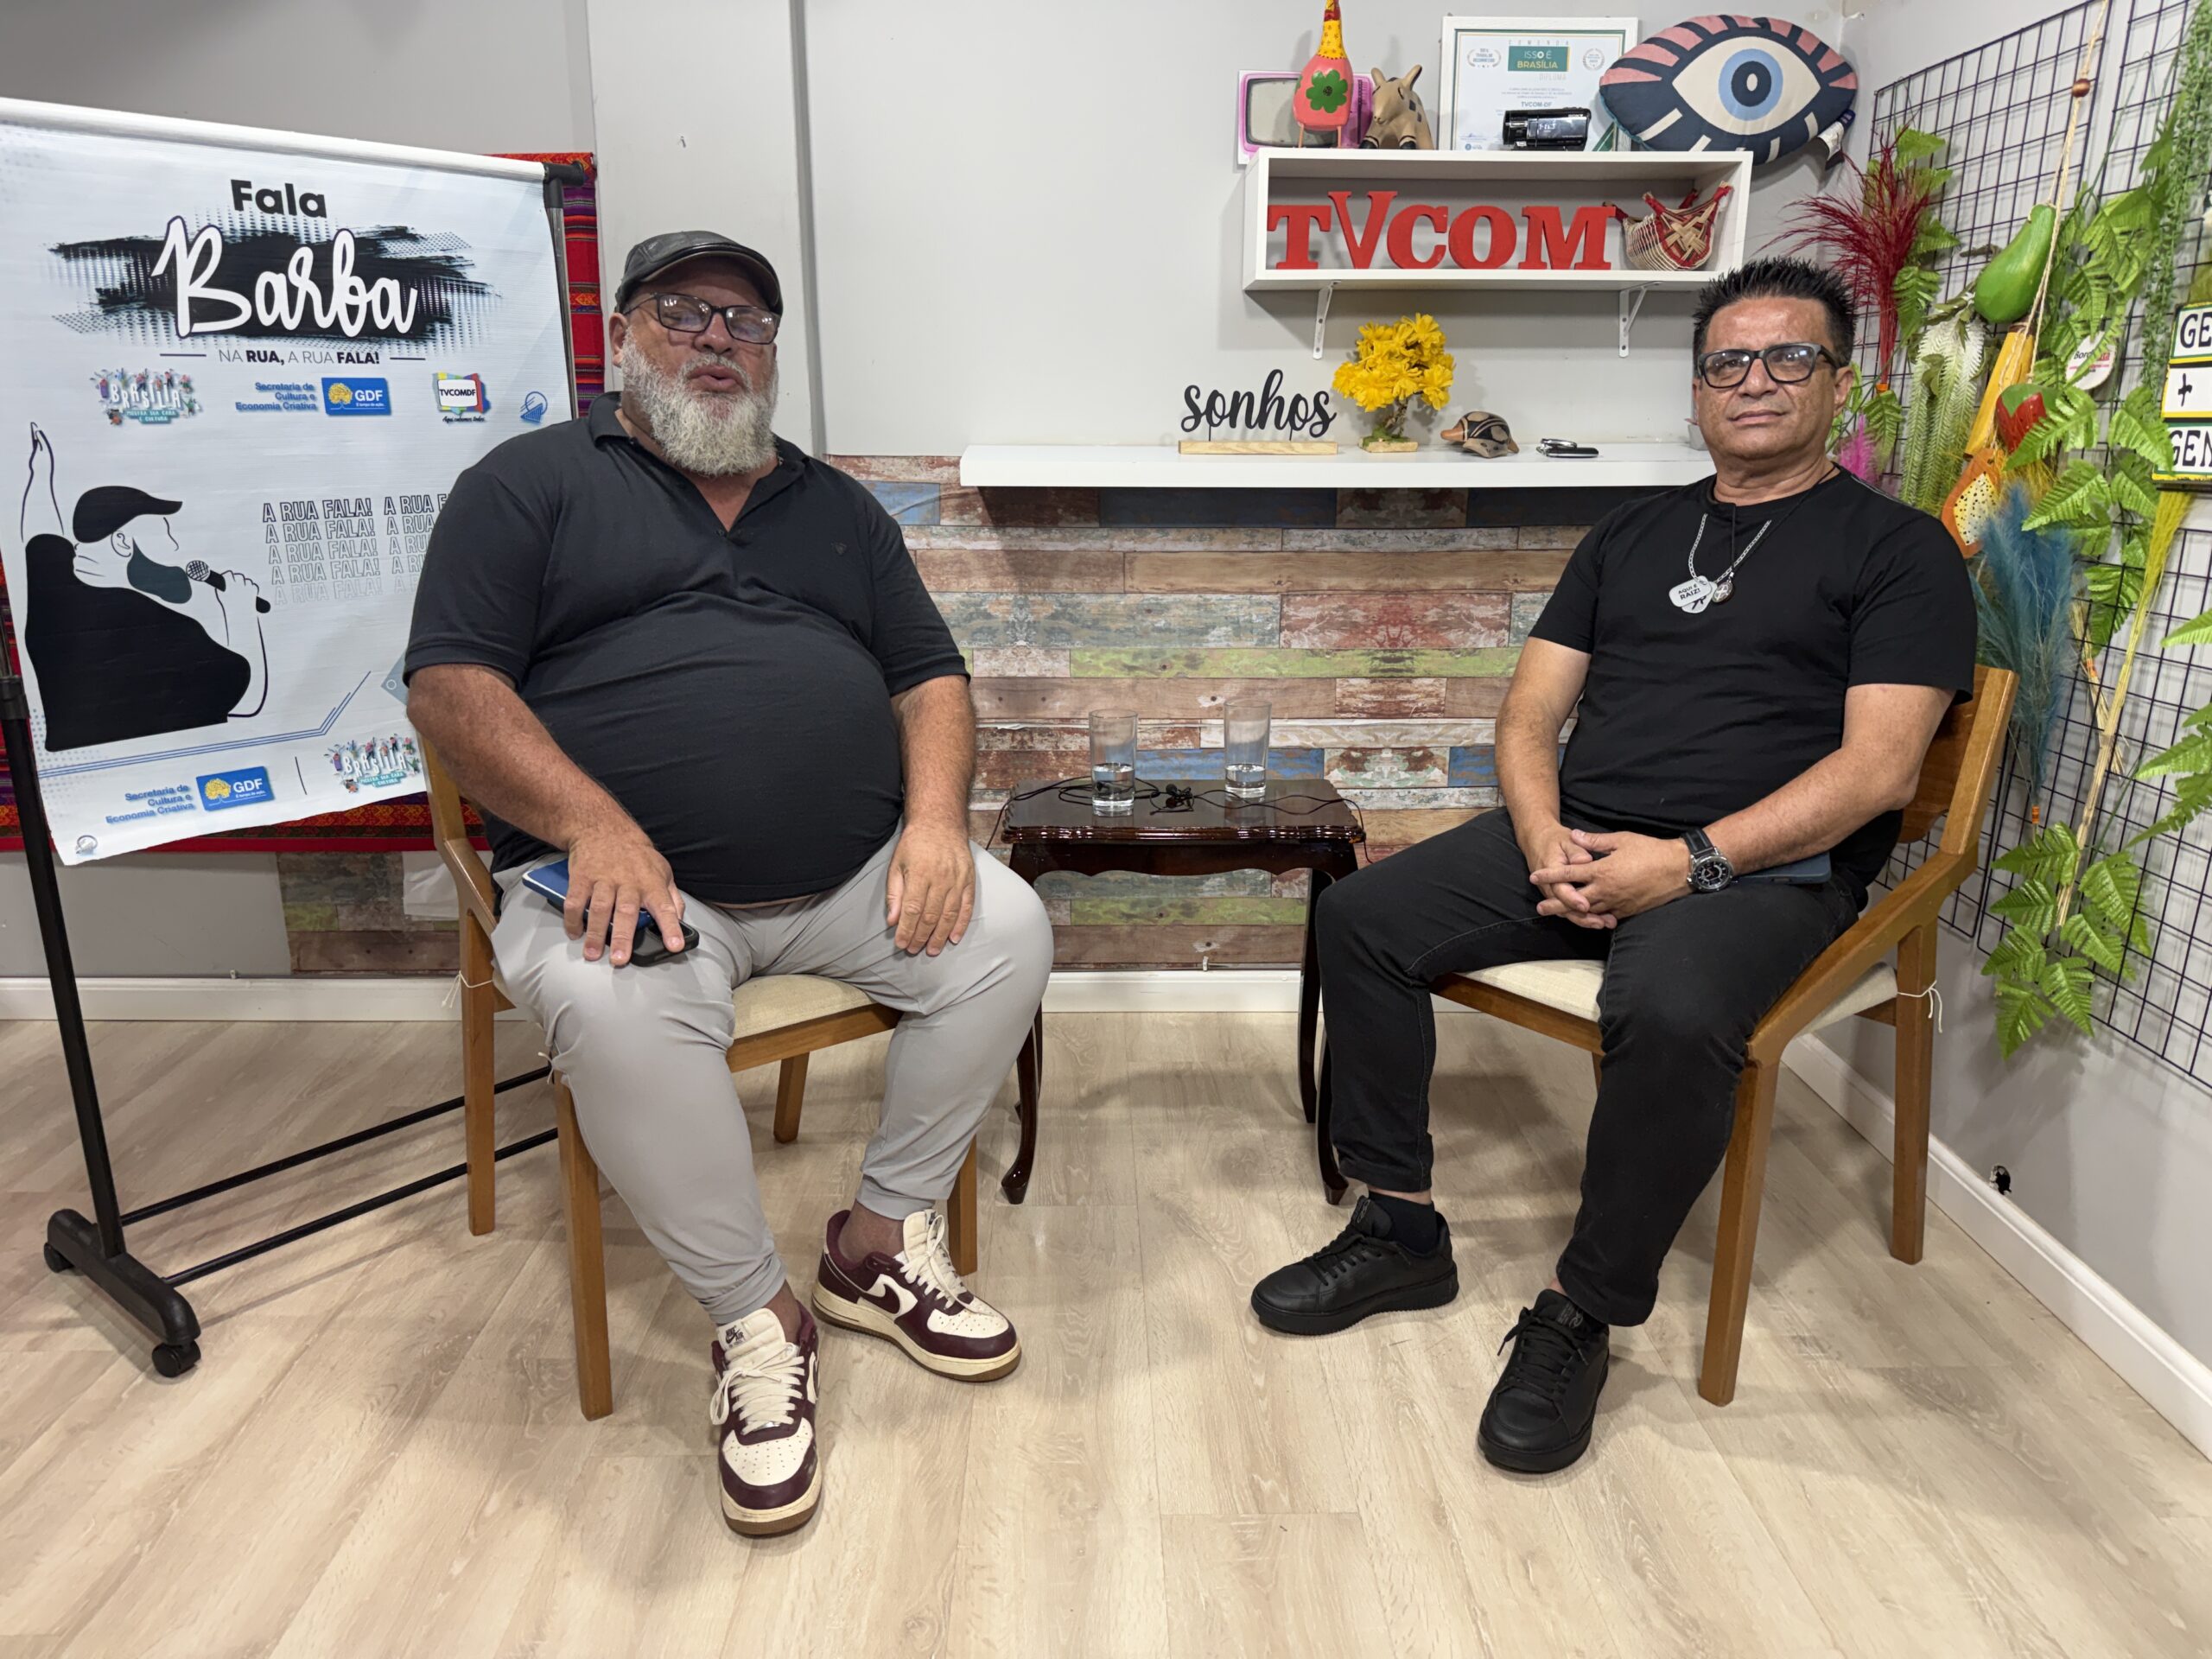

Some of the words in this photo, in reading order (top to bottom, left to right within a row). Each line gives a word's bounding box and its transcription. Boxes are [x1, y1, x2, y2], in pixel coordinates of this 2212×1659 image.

[1524, 51, 1544, 60] ISSO
[1516, 59, 1559, 69] BRASÍLIA
[230, 179, 327, 218] Fala
[1267, 190, 1617, 270] TVCOM
[151, 215, 418, 339] Barba
[218, 349, 244, 363] NA
[245, 350, 285, 365] RUA,
[288, 351, 300, 364] A
[302, 352, 335, 364] RUA
[336, 351, 380, 365] FALA!
[255, 382, 300, 391] Secretaria
[302, 382, 314, 391] de
[275, 392, 307, 401] Cultura
[354, 390, 383, 402] GDF
[1181, 369, 1337, 438] sonhos
[235, 402, 281, 410] Economia
[283, 402, 317, 410] Criativa
[263, 503, 276, 523] A
[280, 500, 319, 521] RUA
[322, 498, 373, 518] FALA!
[384, 496, 397, 515] A
[399, 494, 435, 514] RUA
[265, 524, 279, 543] A
[283, 521, 321, 543] RUA
[325, 518, 376, 539] FALA!
[386, 517, 398, 535] A
[402, 514, 435, 534] RUA
[269, 544, 282, 564] A
[286, 542, 324, 563] RUA
[327, 538, 378, 560] FALA!
[389, 536, 401, 555] A
[404, 534, 431, 554] RU
[271, 566, 284, 585] A
[289, 563, 327, 583] RUA
[330, 558, 381, 580] FALA!
[391, 556, 404, 575] A
[1678, 586, 1693, 594] AQUI
[1680, 588, 1700, 601] RAIZ!
[232, 779, 263, 793] GDF
[125, 787, 175, 802] Secretaria
[148, 795, 184, 807] Cultura
[105, 809, 156, 823] Economia
[156, 803, 194, 815] Criativa
